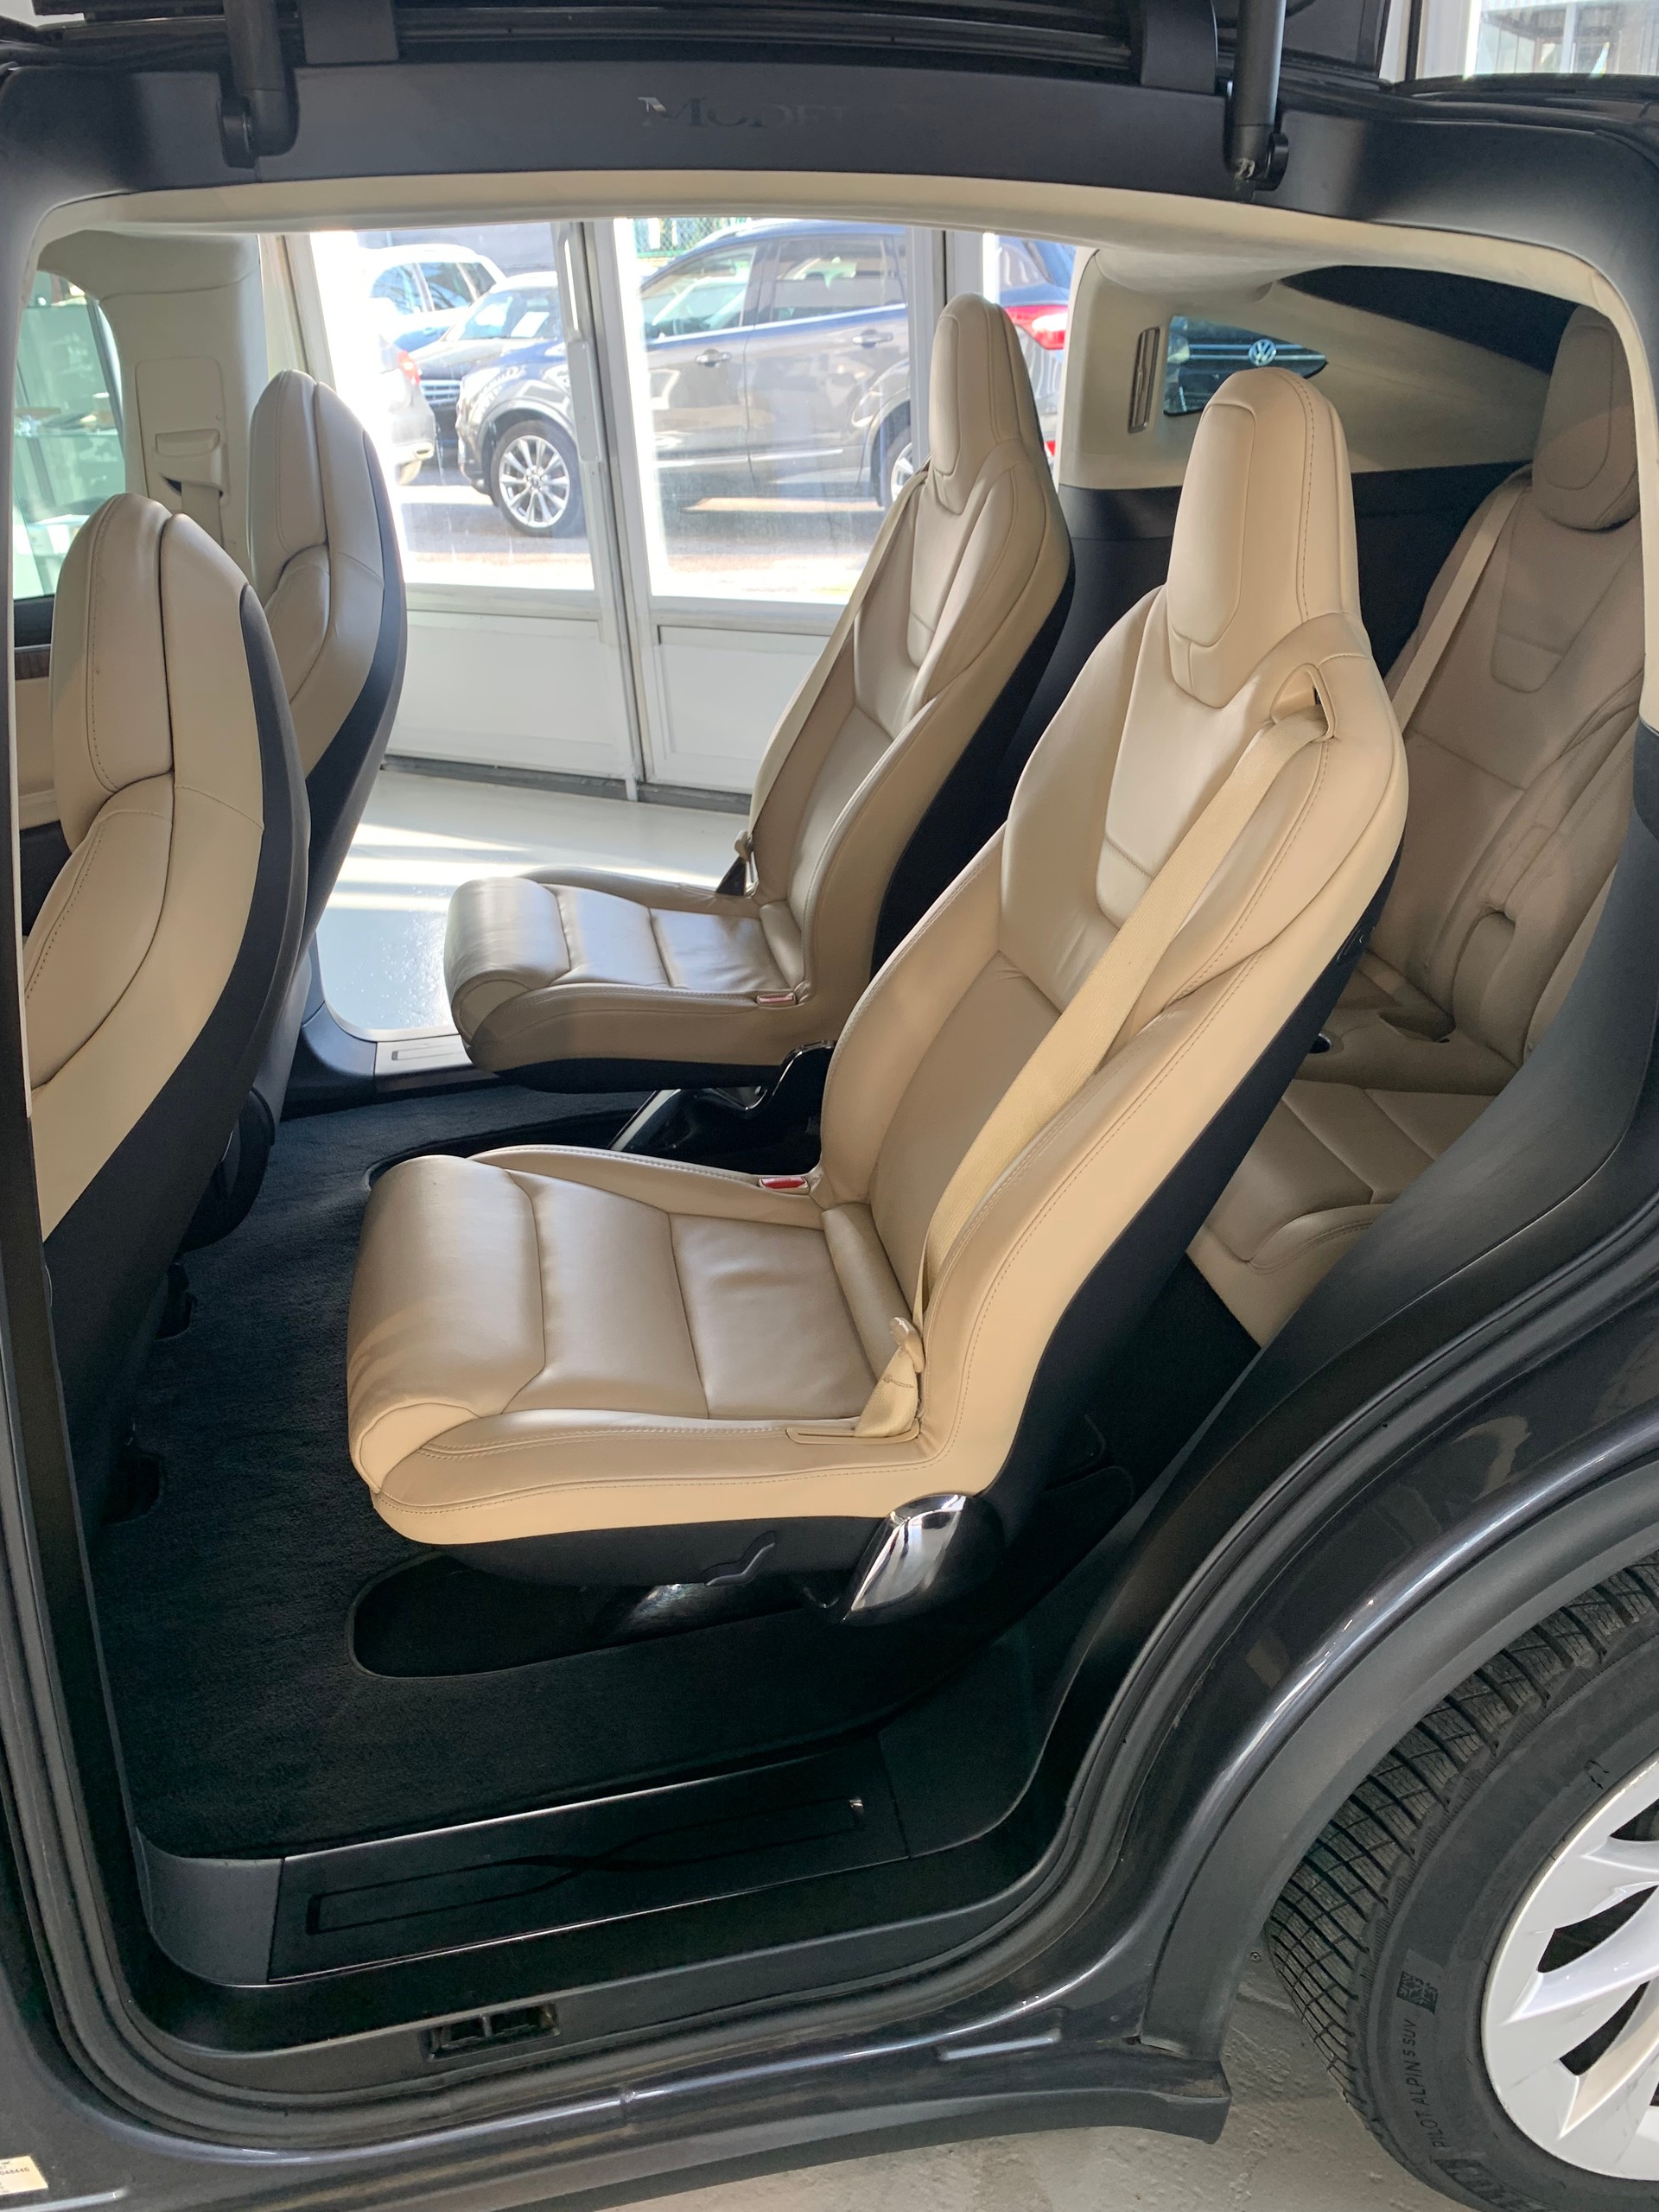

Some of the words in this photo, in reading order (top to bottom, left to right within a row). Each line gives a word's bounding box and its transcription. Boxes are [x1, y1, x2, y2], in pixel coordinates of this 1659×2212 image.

[1402, 2018, 1417, 2046] SUV
[1404, 2060, 1430, 2106] ALPIN
[1414, 2109, 1452, 2147] PILOT
